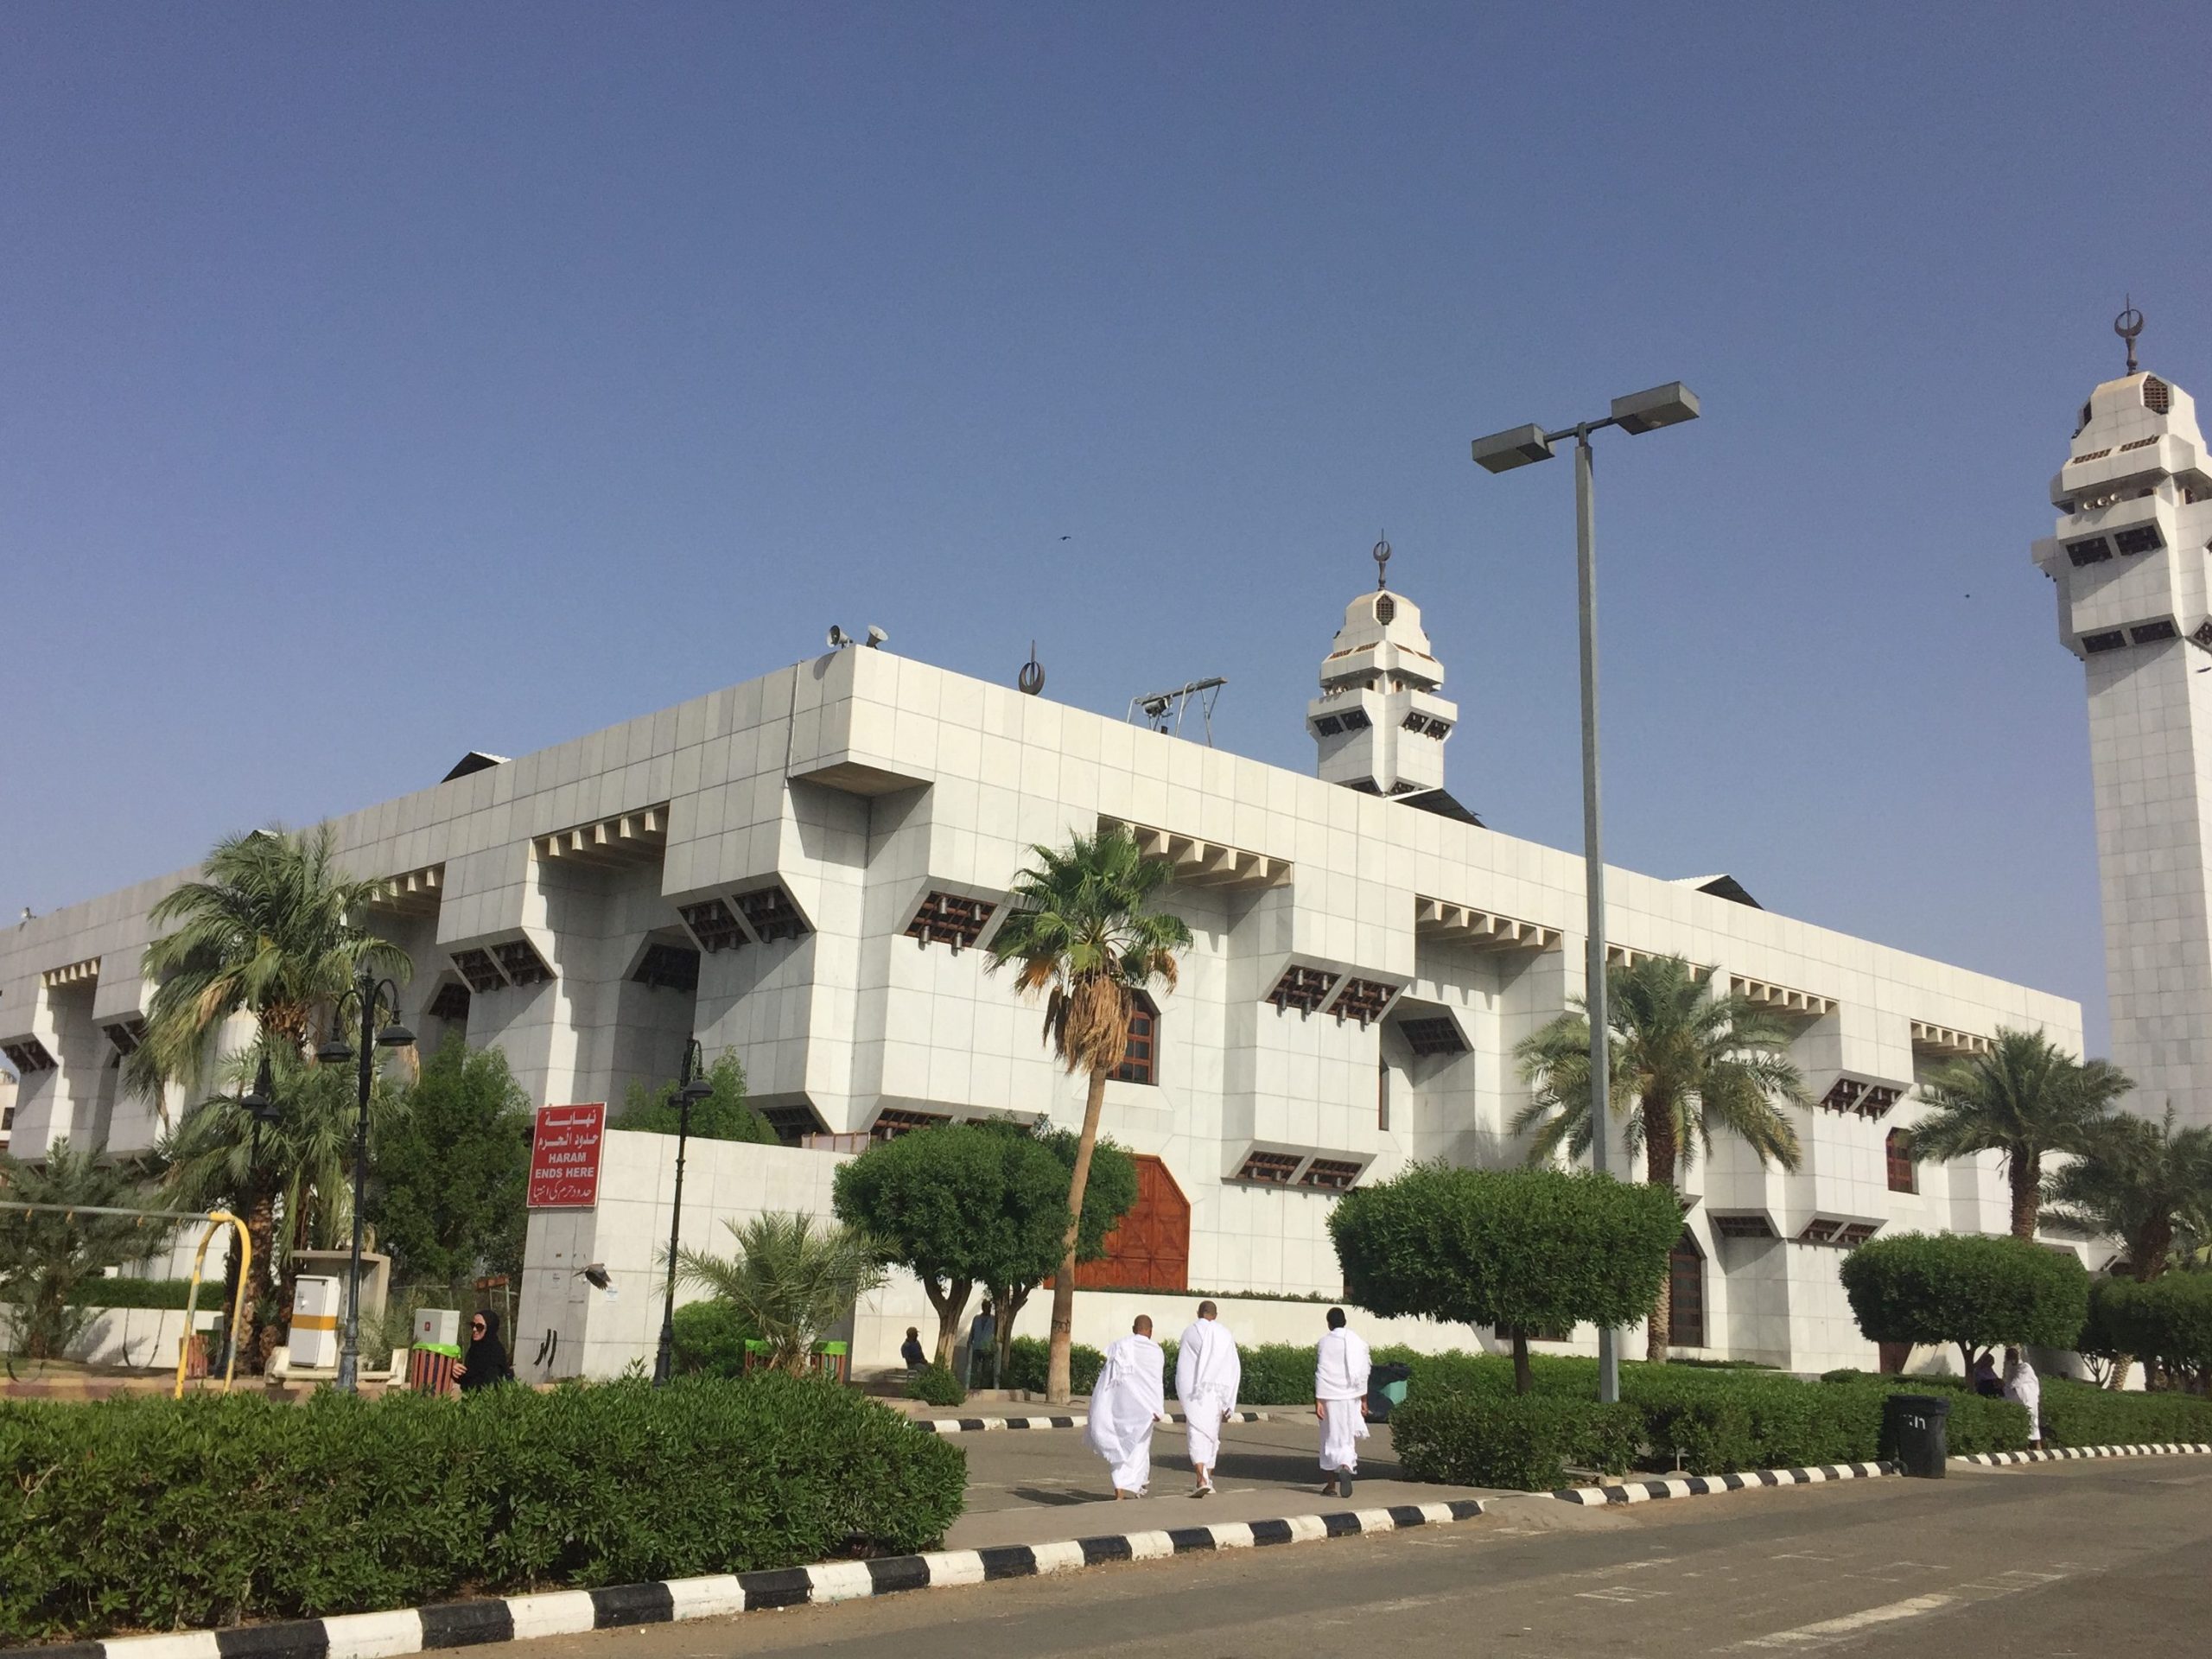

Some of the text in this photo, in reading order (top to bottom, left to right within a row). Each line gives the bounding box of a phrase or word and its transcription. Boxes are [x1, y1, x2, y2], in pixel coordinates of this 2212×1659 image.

[545, 1109, 596, 1130] نهاية
[538, 1132, 599, 1150] حدود الحرم
[549, 1152, 587, 1164] HARAM
[535, 1166, 594, 1179] ENDS HERE
